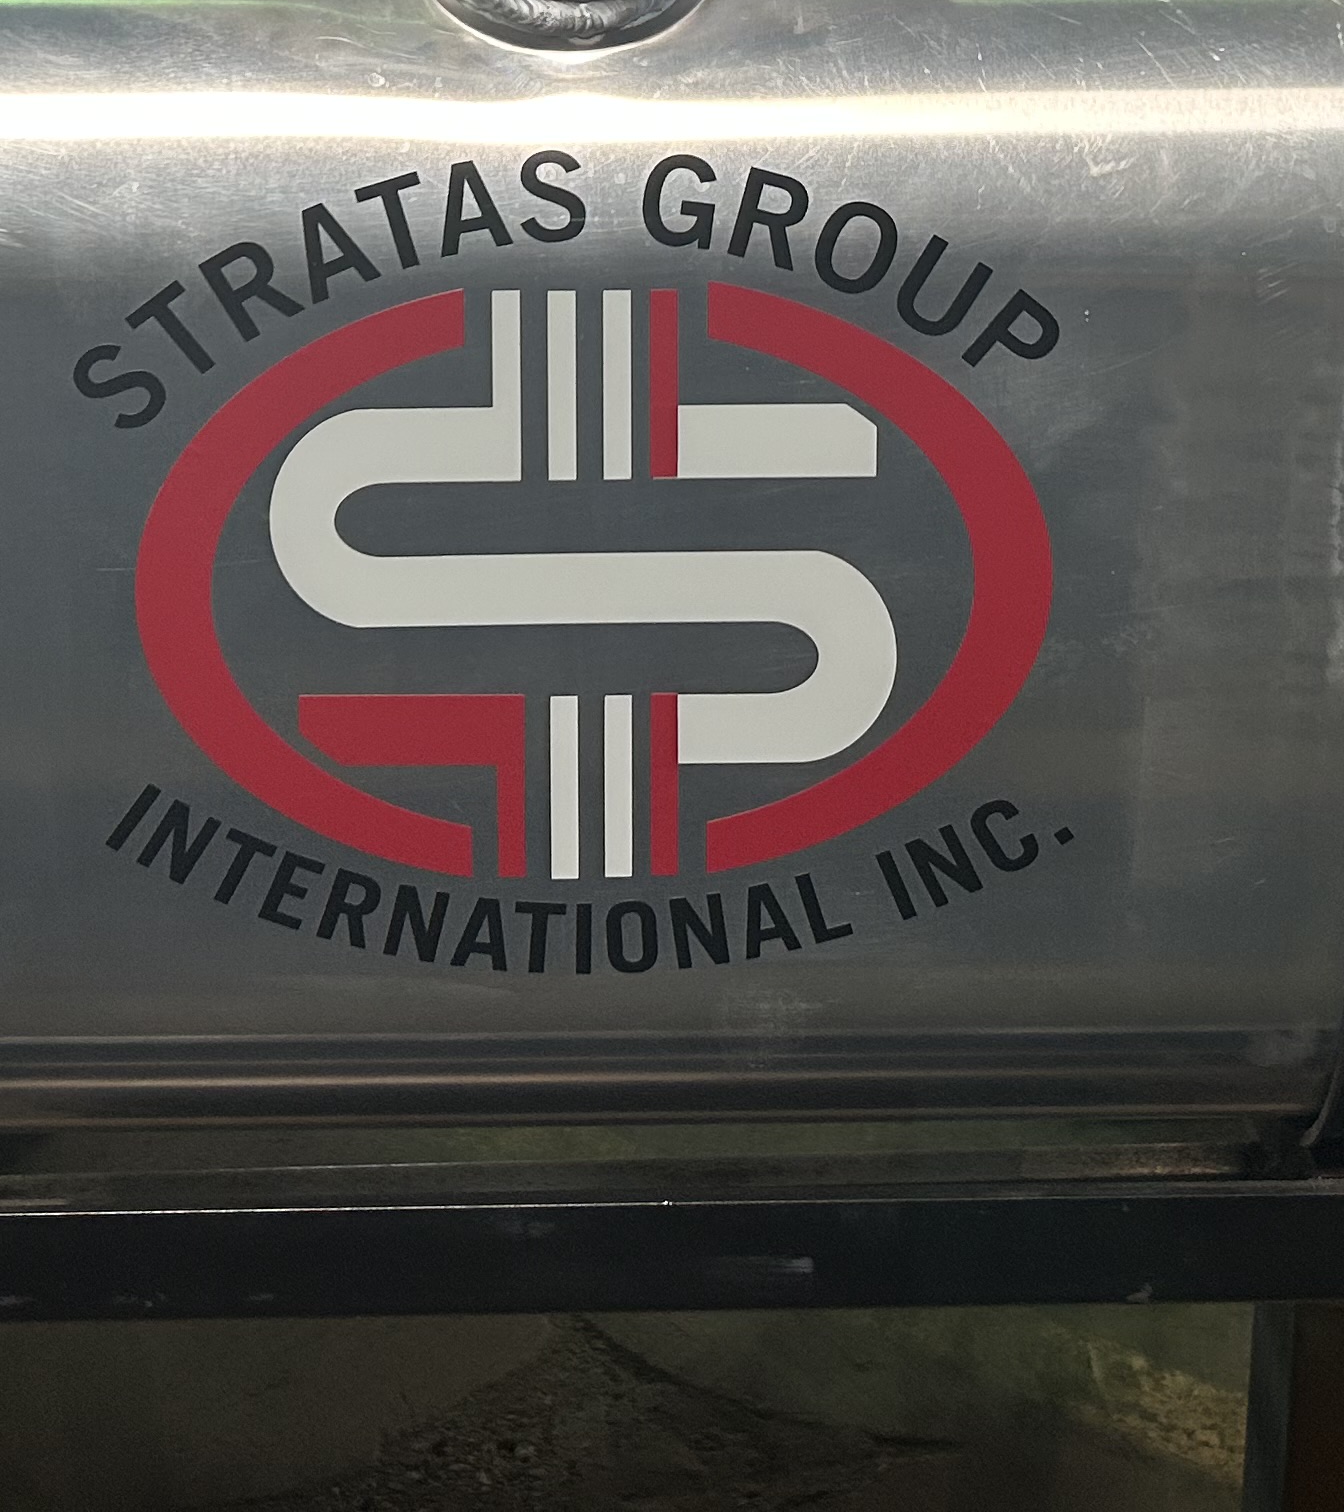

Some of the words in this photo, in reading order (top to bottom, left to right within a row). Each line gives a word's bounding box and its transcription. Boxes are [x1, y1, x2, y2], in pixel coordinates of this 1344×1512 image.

[72, 150, 587, 430] STRATAS
[642, 155, 1060, 368] GROUP
[105, 784, 853, 975] INTERNATIONAL
[875, 799, 1075, 920] INC.
